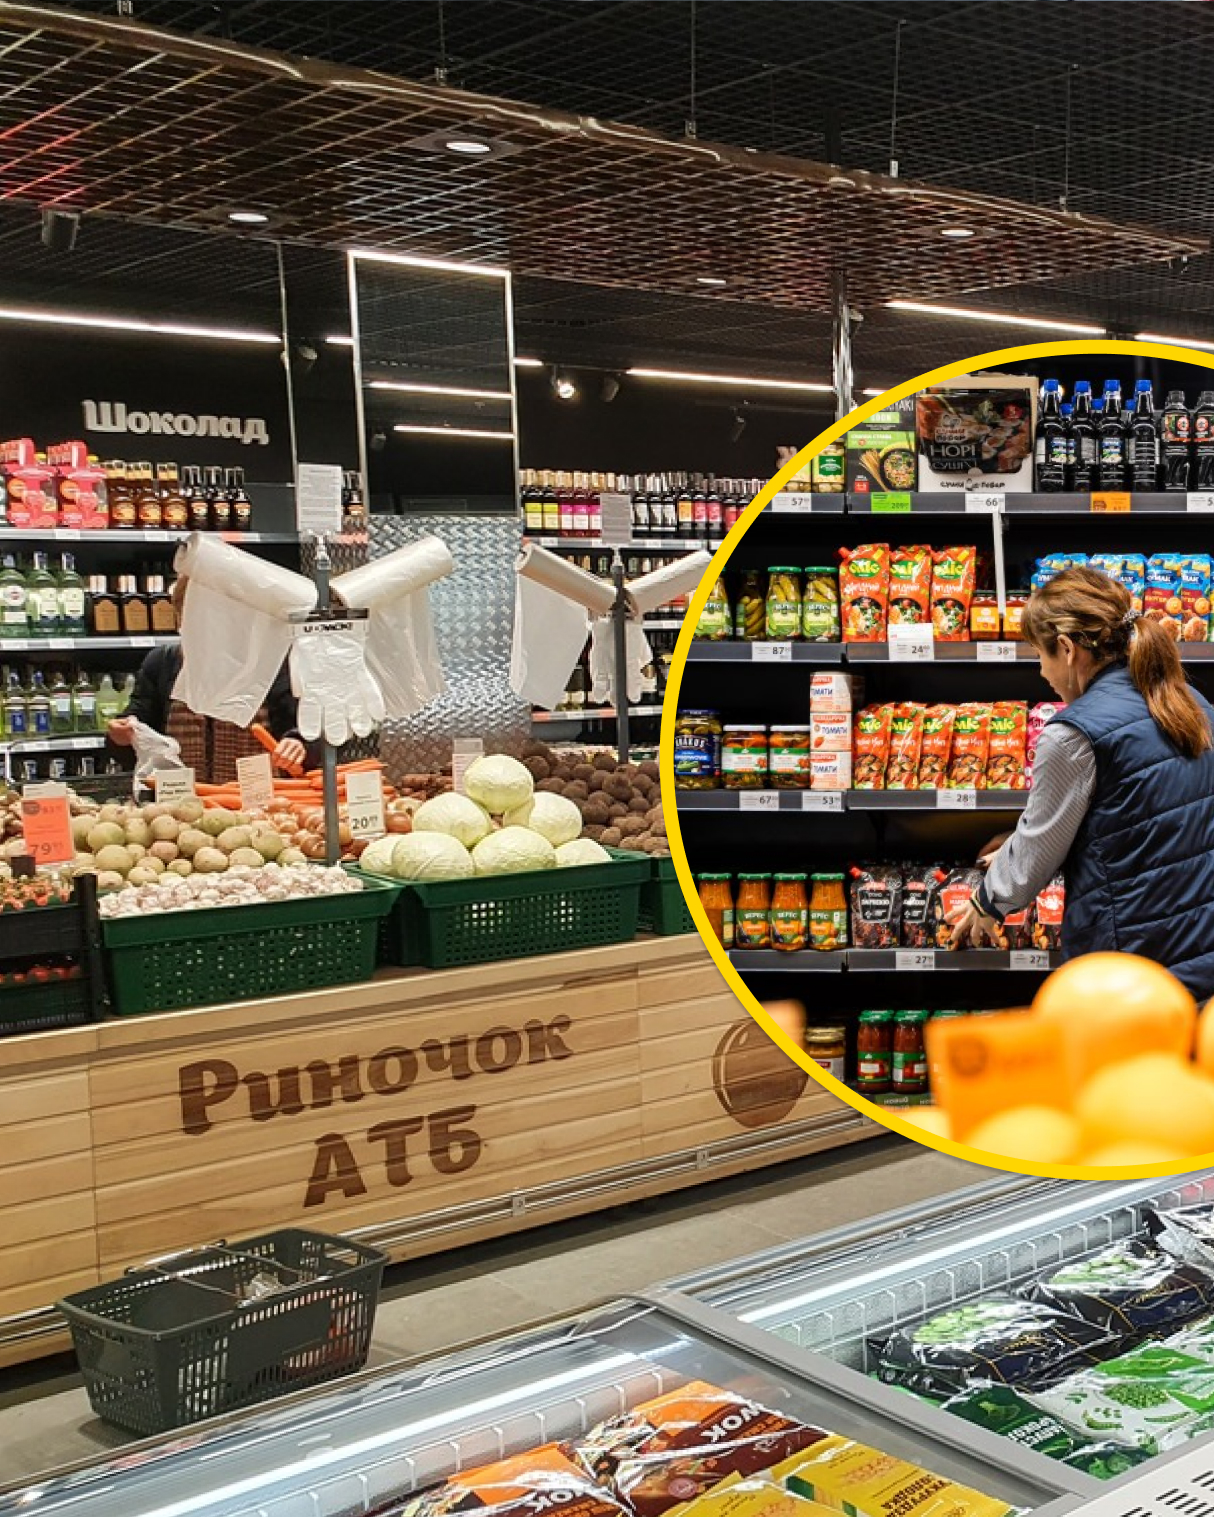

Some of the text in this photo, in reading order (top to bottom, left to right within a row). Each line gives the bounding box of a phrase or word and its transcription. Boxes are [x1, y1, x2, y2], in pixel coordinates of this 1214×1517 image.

[82, 399, 269, 445] Шоколад
[352, 816, 369, 830] 20
[28, 842, 53, 856] 79
[178, 1013, 574, 1135] Риночок
[303, 1103, 483, 1209] АТБ
